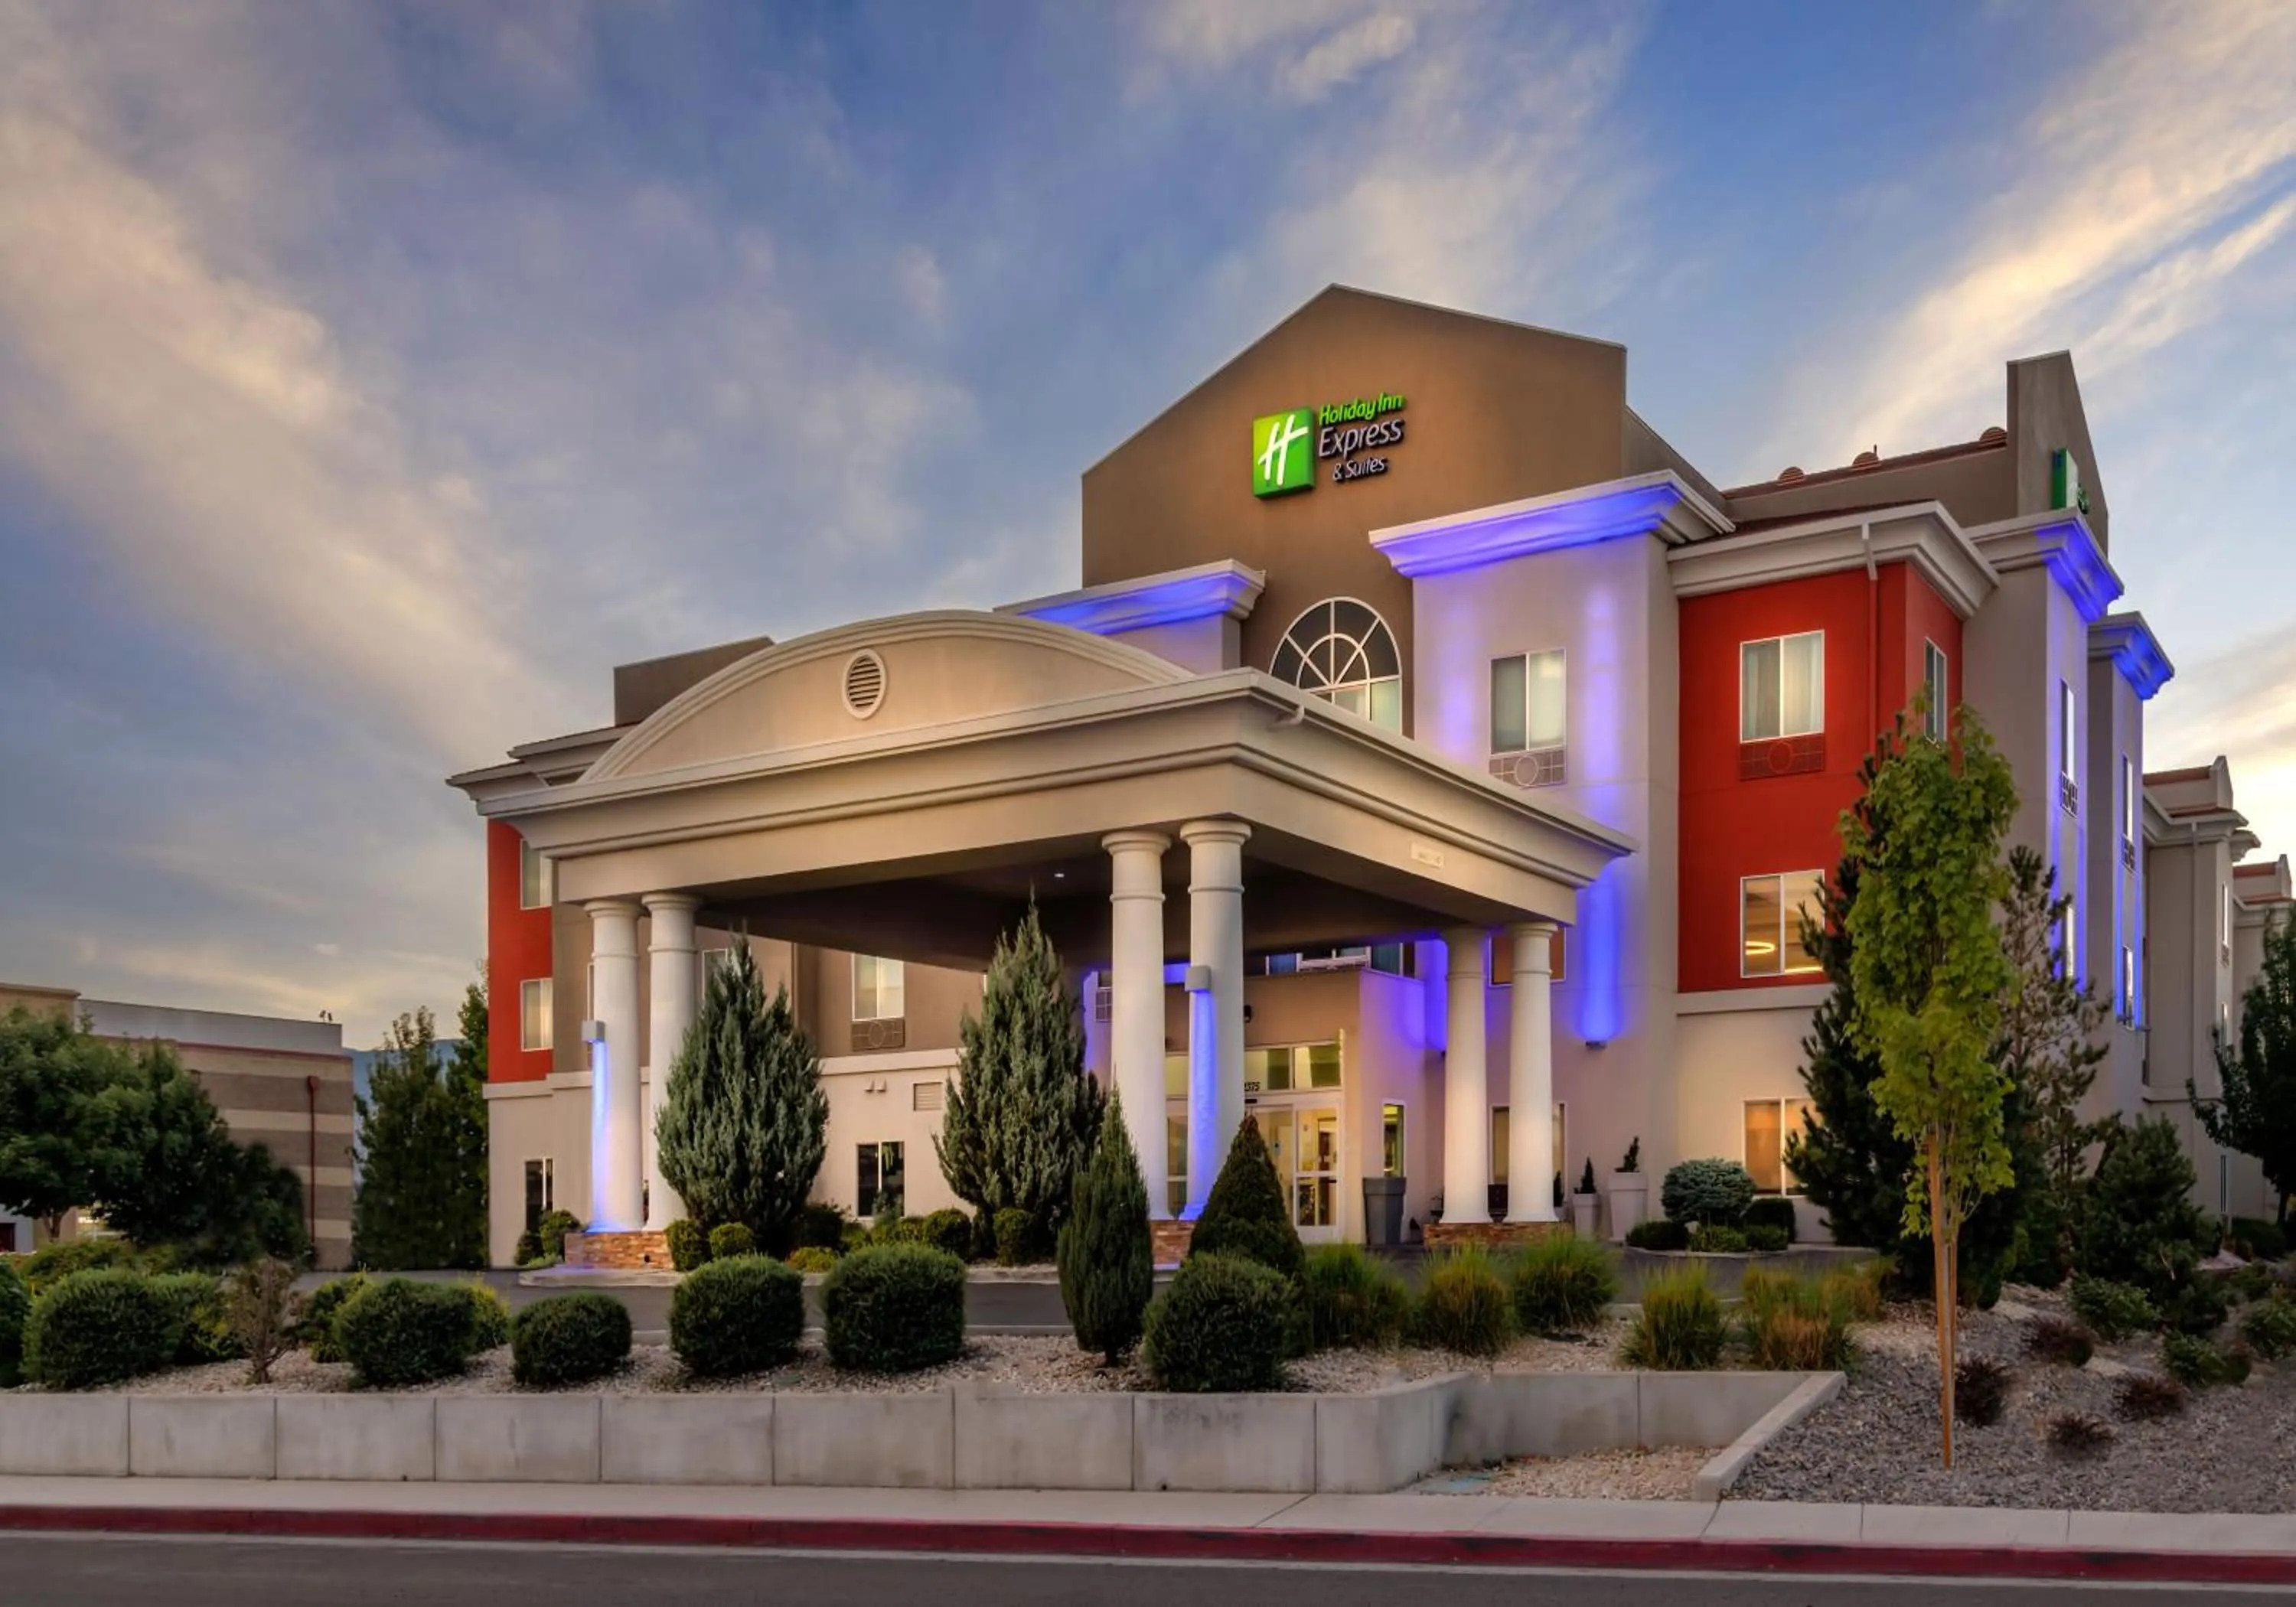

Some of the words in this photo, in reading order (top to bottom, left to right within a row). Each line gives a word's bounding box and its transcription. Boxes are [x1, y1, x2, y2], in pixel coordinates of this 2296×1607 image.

[1319, 398, 1377, 426] Holiday
[1378, 391, 1404, 412] Inn
[1257, 414, 1309, 486] H
[1319, 419, 1403, 460] Express
[1332, 463, 1343, 481] &
[1345, 457, 1386, 478] Suites
